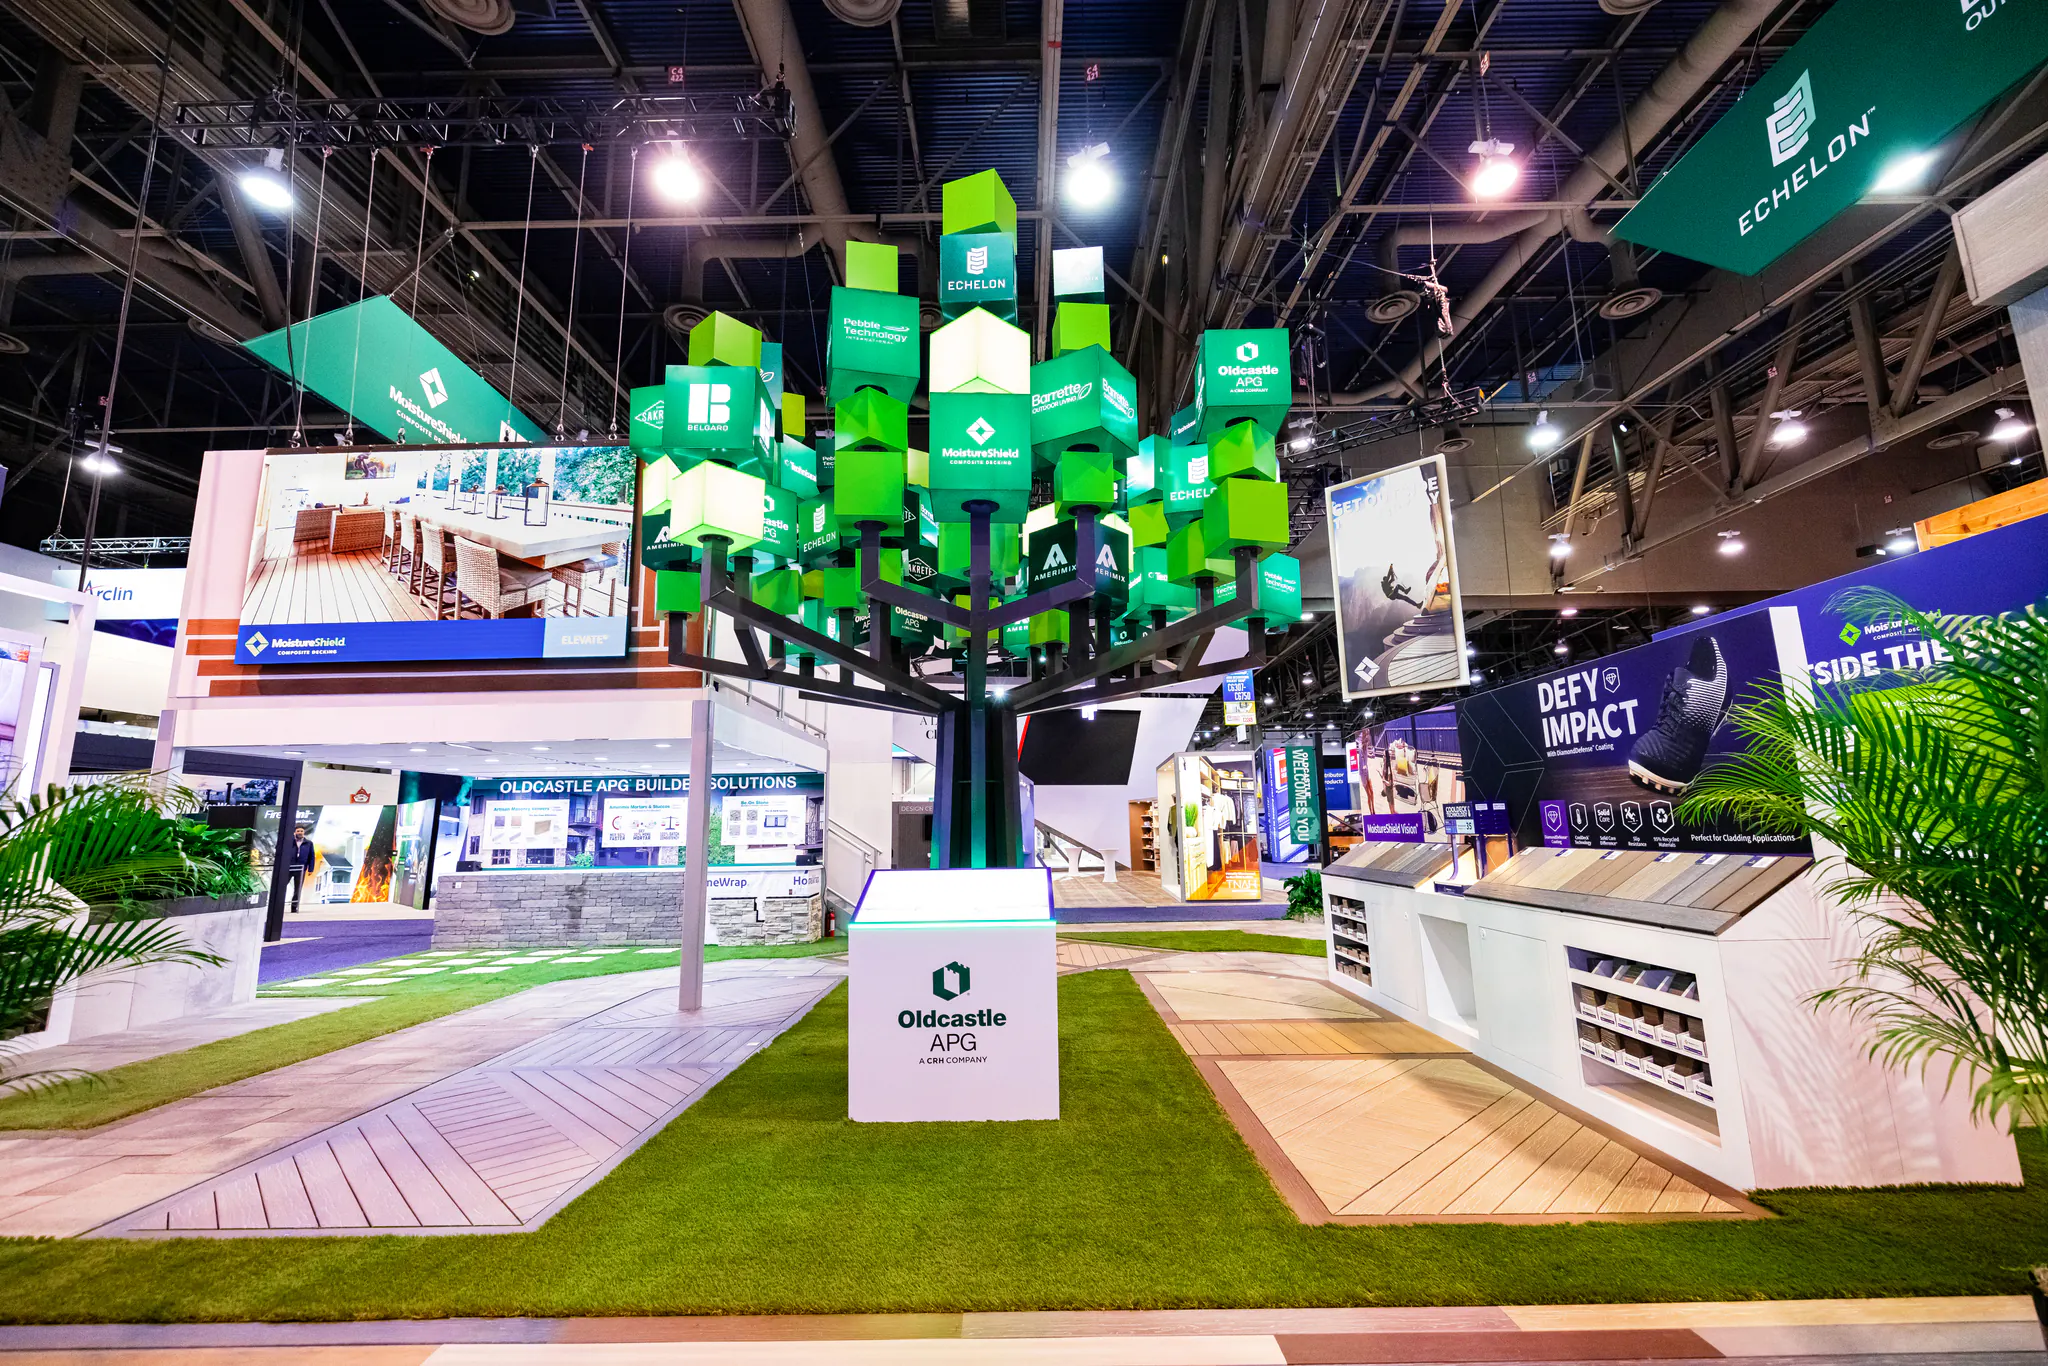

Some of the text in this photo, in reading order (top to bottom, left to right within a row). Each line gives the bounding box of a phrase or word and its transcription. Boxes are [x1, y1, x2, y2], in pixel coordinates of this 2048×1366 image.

[947, 279, 1016, 291] ECHELON
[843, 317, 881, 331] Pebble
[844, 326, 908, 343] Technology
[1218, 364, 1279, 376] Oldcastle
[1236, 377, 1263, 387] APG
[1032, 383, 1081, 407] Barrette
[1032, 395, 1078, 414] OUTDOOR LIVING
[396, 409, 433, 438] COMPOSITE
[641, 409, 664, 422] SAKR
[942, 448, 1019, 458] MoistureShield
[1170, 487, 1218, 501] ECHEL
[1332, 497, 1362, 517] GET
[646, 541, 685, 550] AMERIMIX
[803, 530, 836, 553] ECHELON
[1034, 563, 1078, 582] AMERIMIX
[83, 580, 133, 601] Arclin
[905, 617, 920, 628] APG
[272, 637, 346, 648] MoistureShield
[1537, 668, 1598, 713] DEFY
[1542, 699, 1639, 748] IMPACT
[1546, 750, 1556, 758] With
[1595, 742, 1615, 751] Coating
[1302, 752, 1312, 799] OLDCASTLE
[500, 776, 797, 794] OLDCASTLE APG BUILDE SOLUTIONS
[1292, 749, 1310, 842] WELCOMES YOU
[1597, 808, 1610, 816] Solid
[1367, 822, 1401, 834] MoistureShield
[1690, 833, 1796, 844] Perfect for Cladding Applications
[898, 1009, 1007, 1029] Oldcastle
[930, 1033, 977, 1052] APG
[946, 1056, 988, 1064] COMPANY
